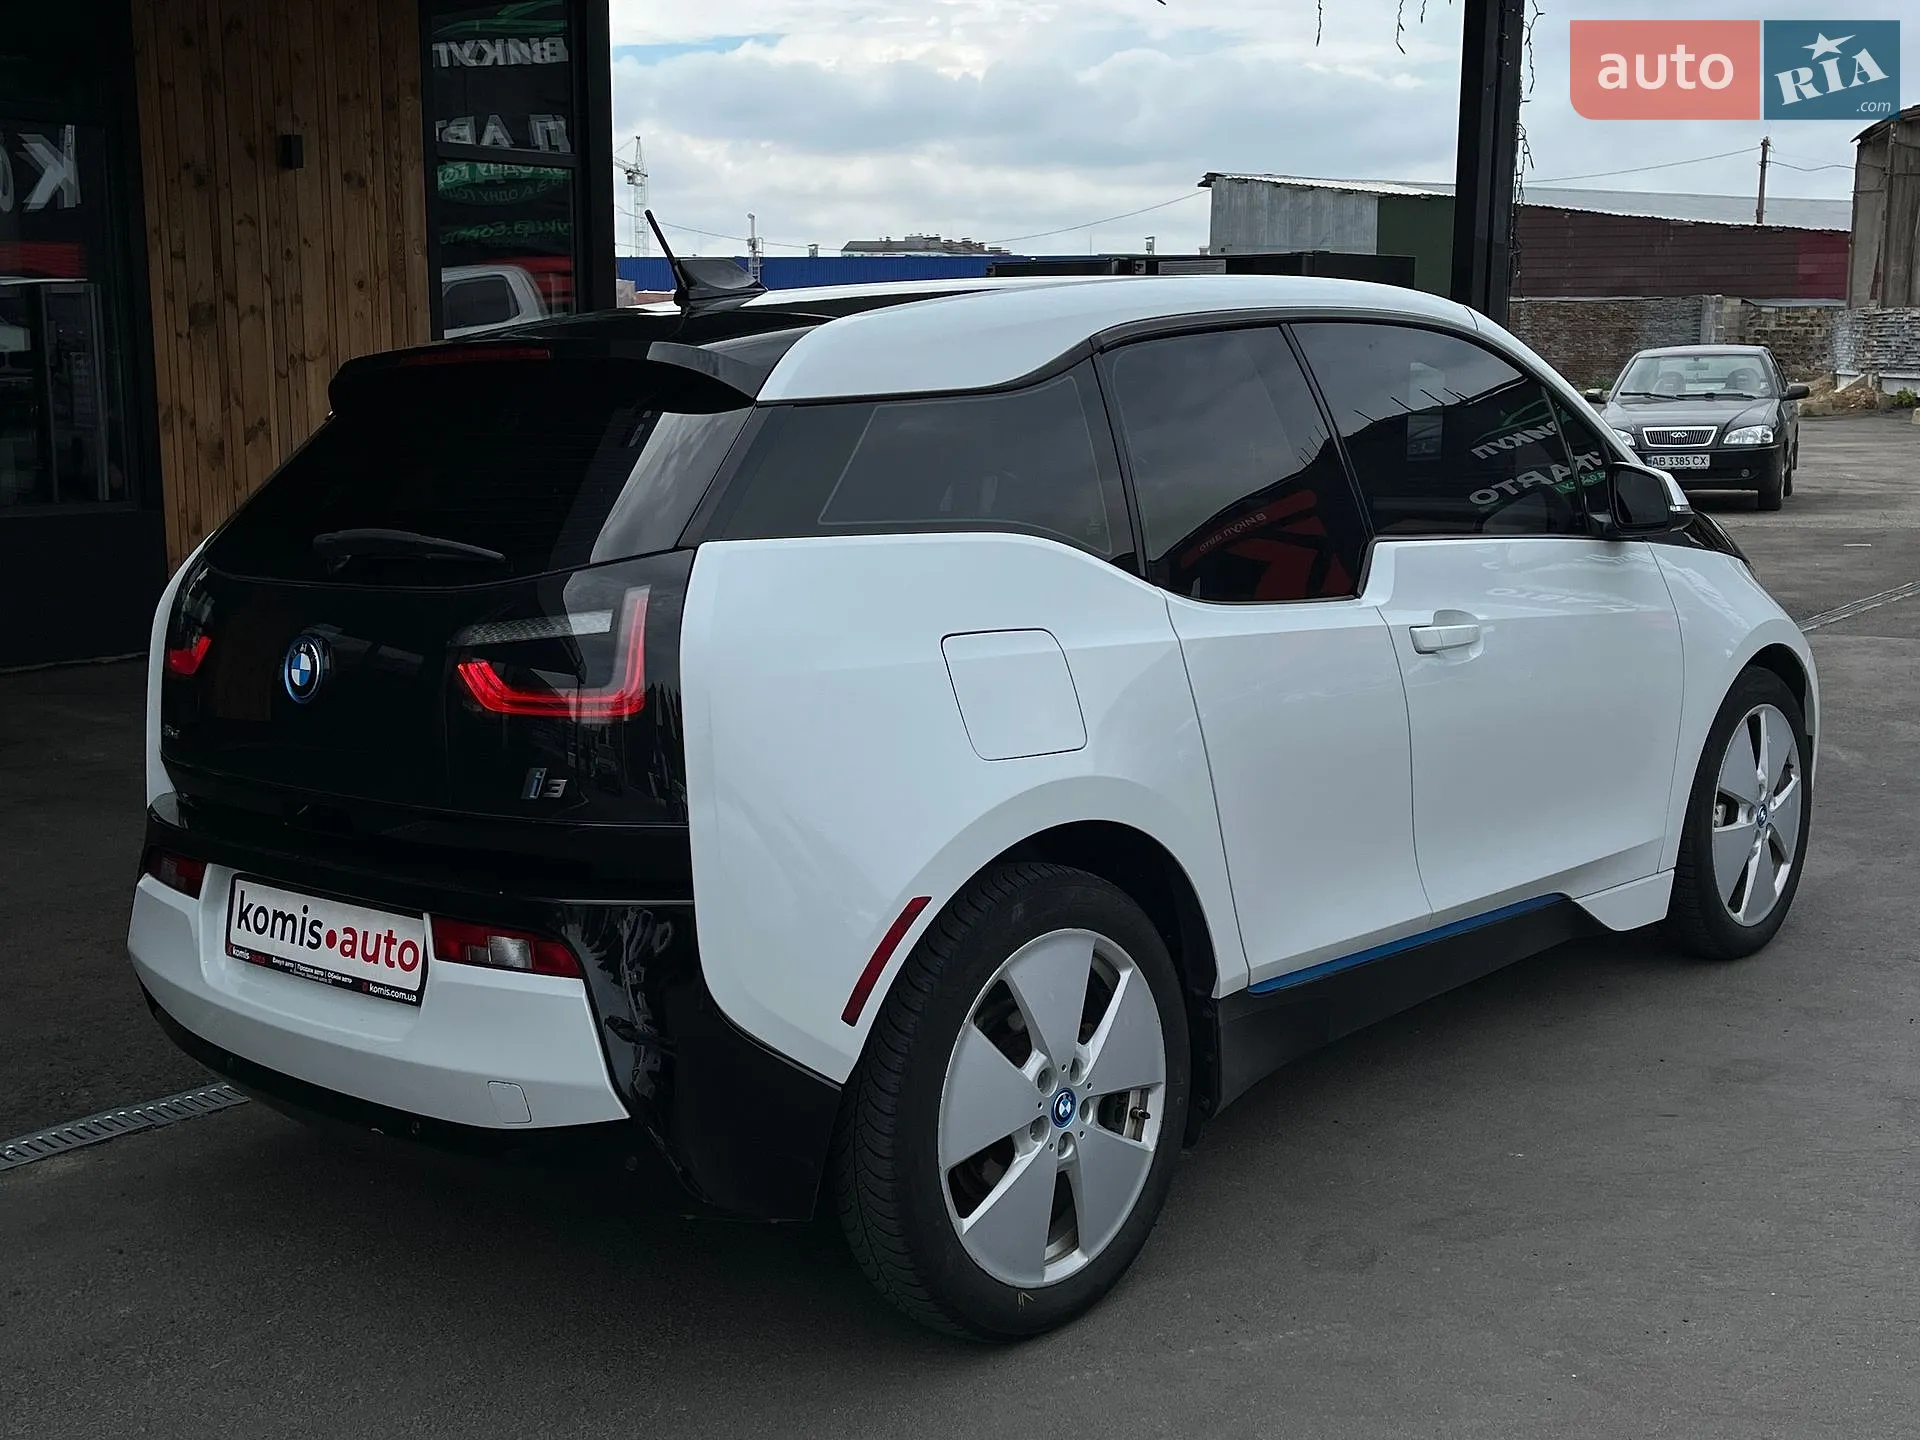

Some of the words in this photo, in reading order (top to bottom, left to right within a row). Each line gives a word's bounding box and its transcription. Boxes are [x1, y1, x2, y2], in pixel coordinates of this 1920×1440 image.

[1668, 456, 1691, 466] 3385
[520, 767, 568, 800] i3
[369, 983, 417, 1002] komis.com.ua
